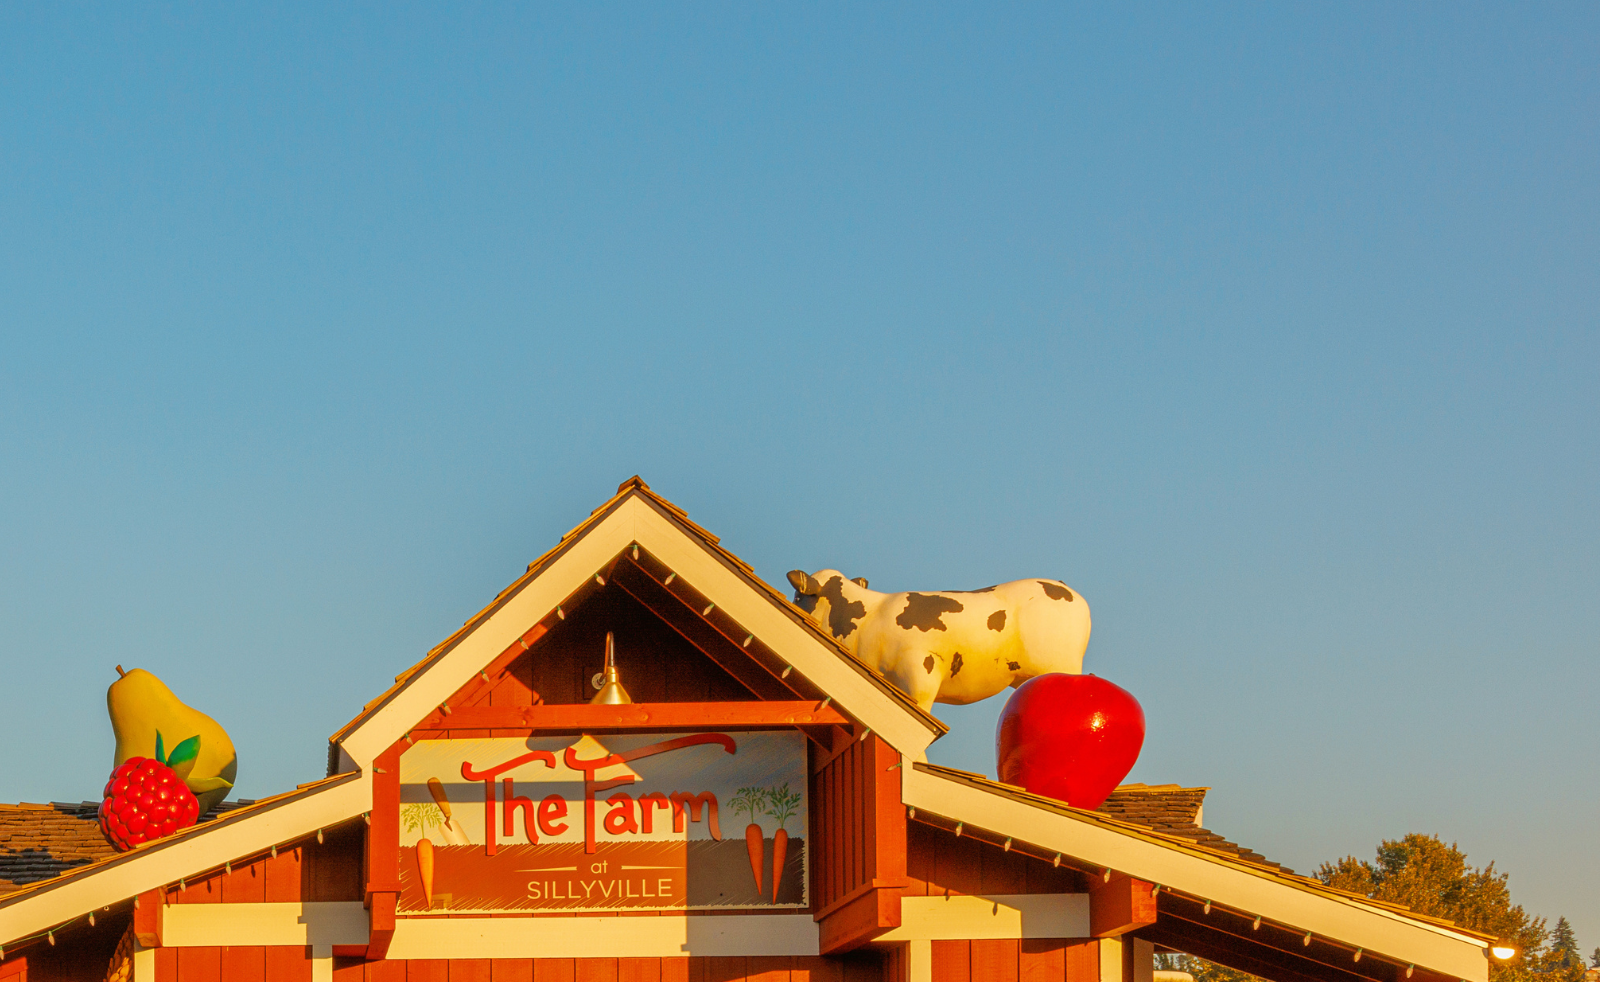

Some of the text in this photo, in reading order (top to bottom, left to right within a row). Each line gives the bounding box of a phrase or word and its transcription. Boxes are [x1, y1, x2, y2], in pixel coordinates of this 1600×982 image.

[460, 733, 737, 856] The Farm
[590, 860, 608, 874] at
[527, 878, 673, 900] SILLYVILLE
